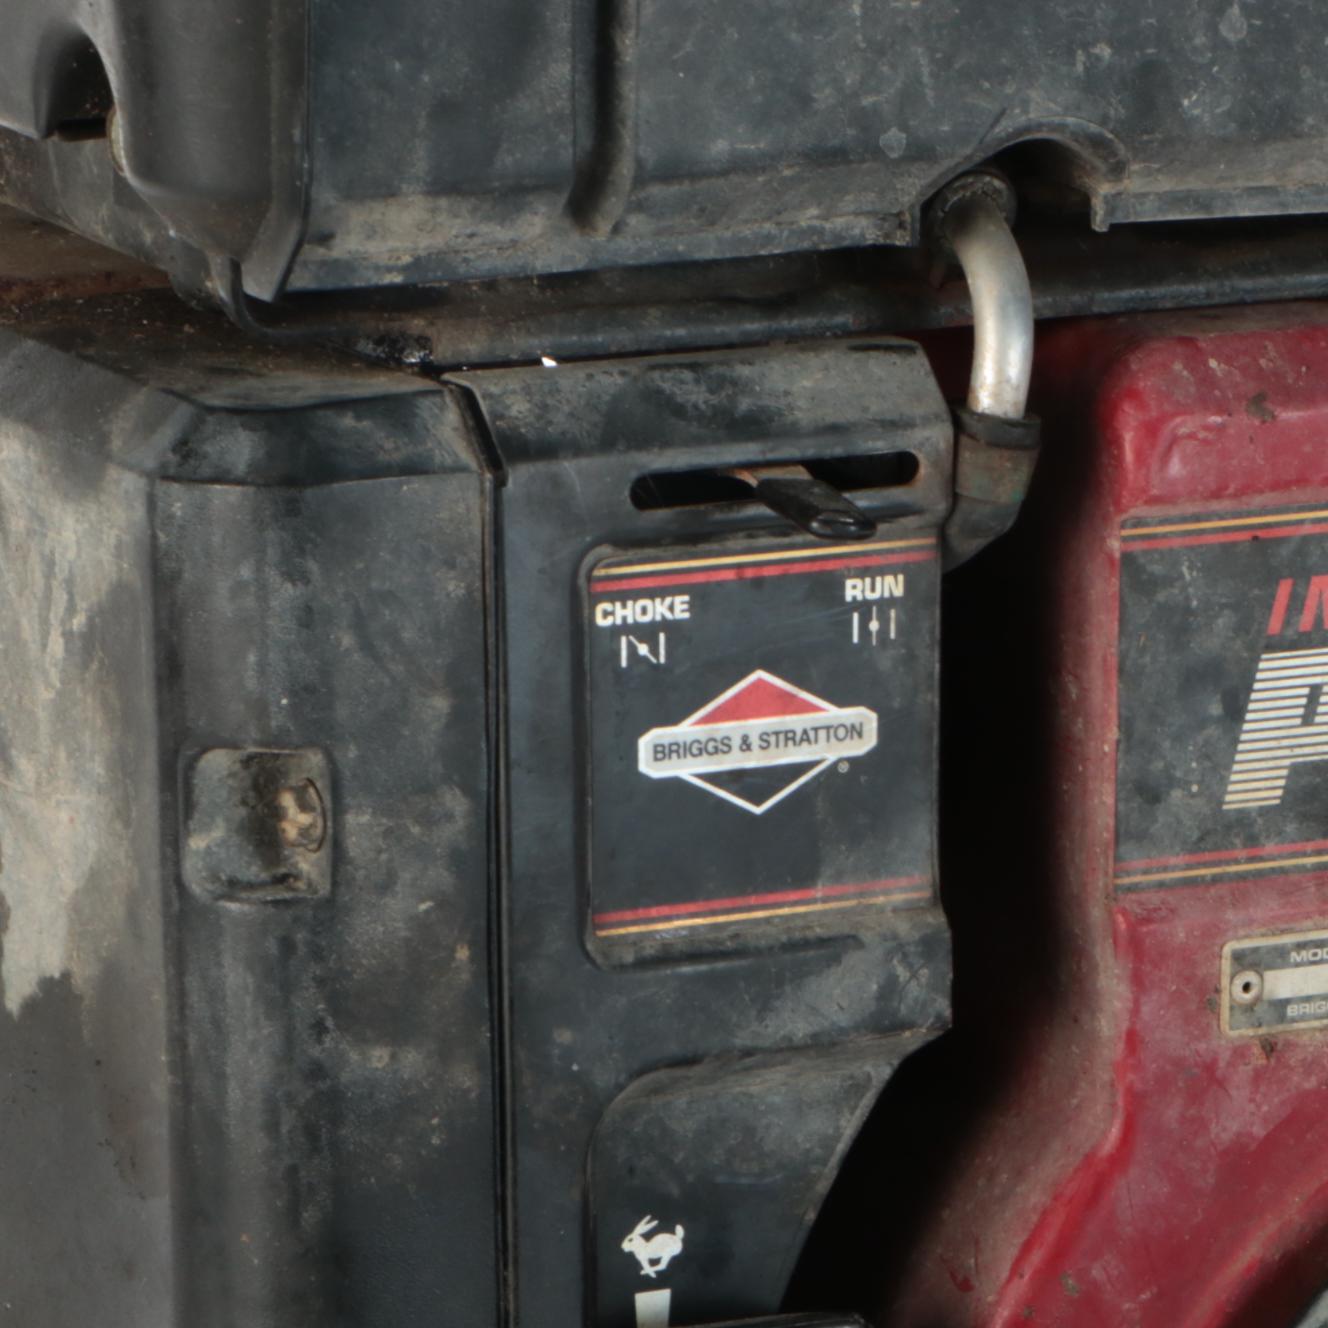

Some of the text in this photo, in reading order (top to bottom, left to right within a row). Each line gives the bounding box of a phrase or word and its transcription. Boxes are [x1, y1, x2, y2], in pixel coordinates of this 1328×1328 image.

[845, 574, 904, 602] RUN
[595, 595, 690, 626] CHOKE
[653, 722, 864, 762] BRIGGS & STRATTON
